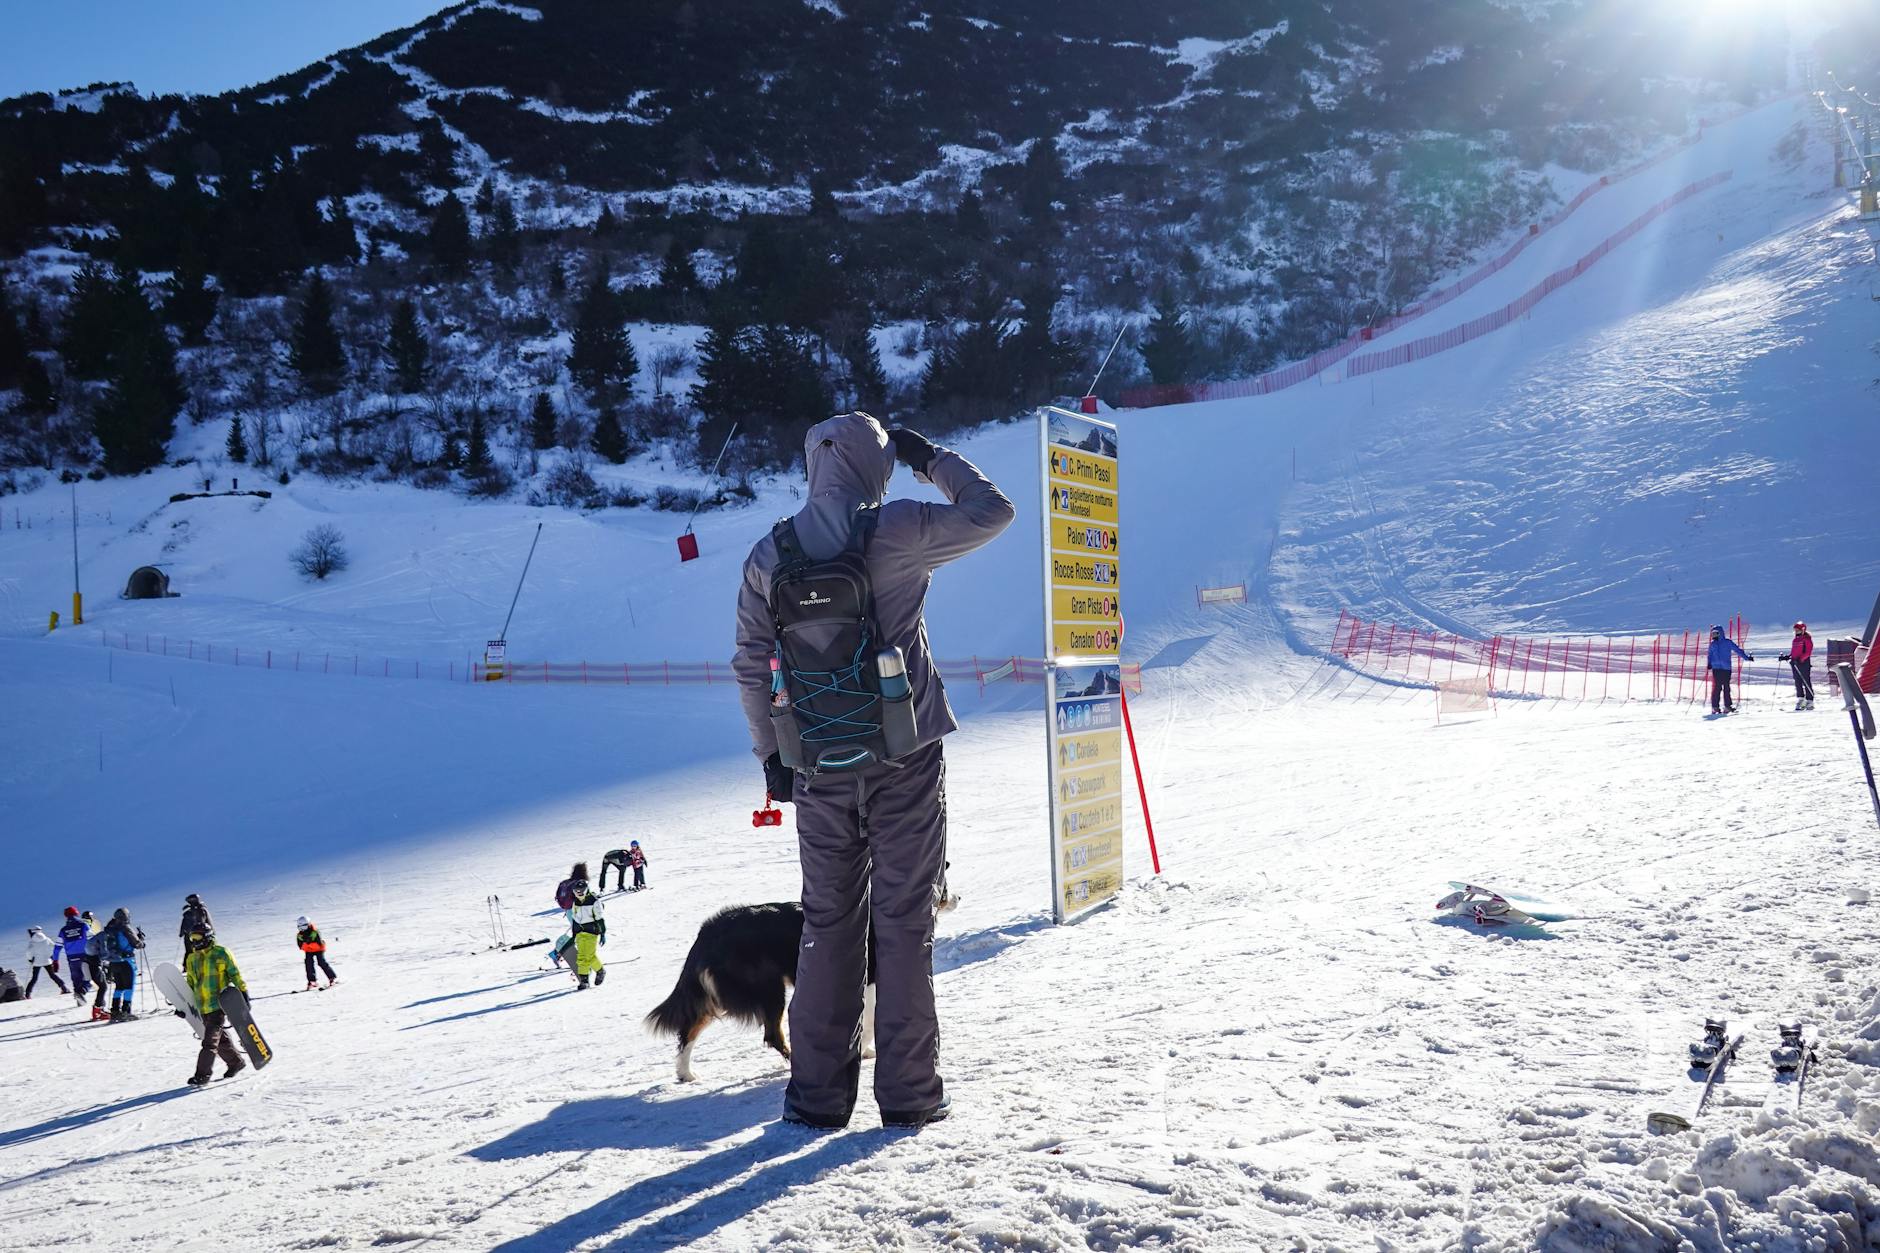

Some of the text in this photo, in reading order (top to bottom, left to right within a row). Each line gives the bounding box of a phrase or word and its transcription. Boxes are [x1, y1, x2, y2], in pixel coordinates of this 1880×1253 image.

[1069, 458, 1111, 483] C. Primi Passi
[1067, 526, 1085, 545] Palon
[1054, 560, 1094, 580] Rocce Rosse
[799, 597, 831, 606] FERRINO
[1071, 596, 1087, 613] Gran
[1087, 597, 1103, 614] Pista
[1070, 631, 1095, 649] Canalon
[1077, 772, 1106, 794] Snowpark
[248, 1023, 271, 1061] HEAD
